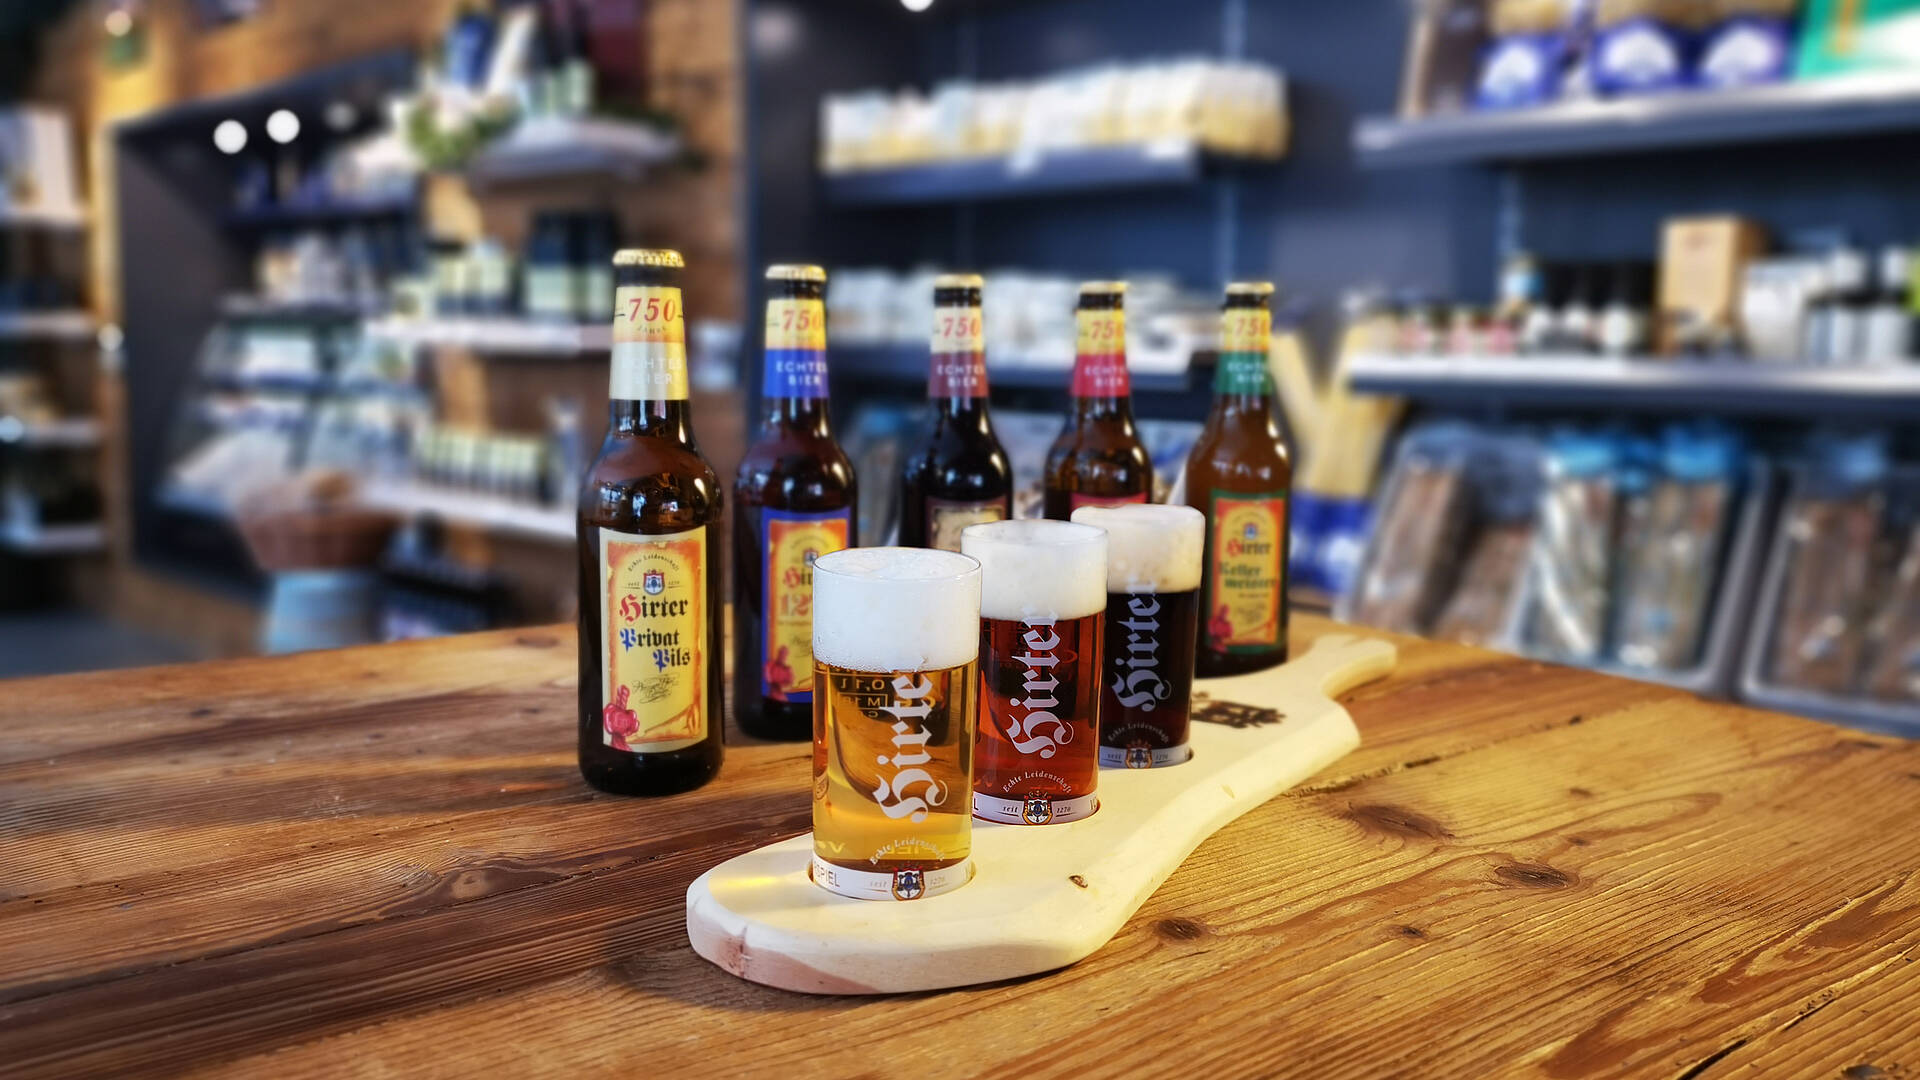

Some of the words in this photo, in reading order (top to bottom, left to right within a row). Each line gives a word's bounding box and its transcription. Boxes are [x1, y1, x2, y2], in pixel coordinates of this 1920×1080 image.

[628, 297, 677, 322] 750
[788, 374, 822, 386] BIER
[948, 376, 978, 388] BIER
[619, 594, 688, 622] Hirter
[620, 627, 680, 652] Privat
[1112, 574, 1172, 712] Hirter
[653, 647, 691, 673] Pils
[1006, 603, 1074, 758] Hirter
[1002, 776, 1022, 793] Echte
[1025, 770, 1072, 793] Leidenschaft
[1003, 805, 1019, 813] seit
[870, 844, 892, 865] Echte
